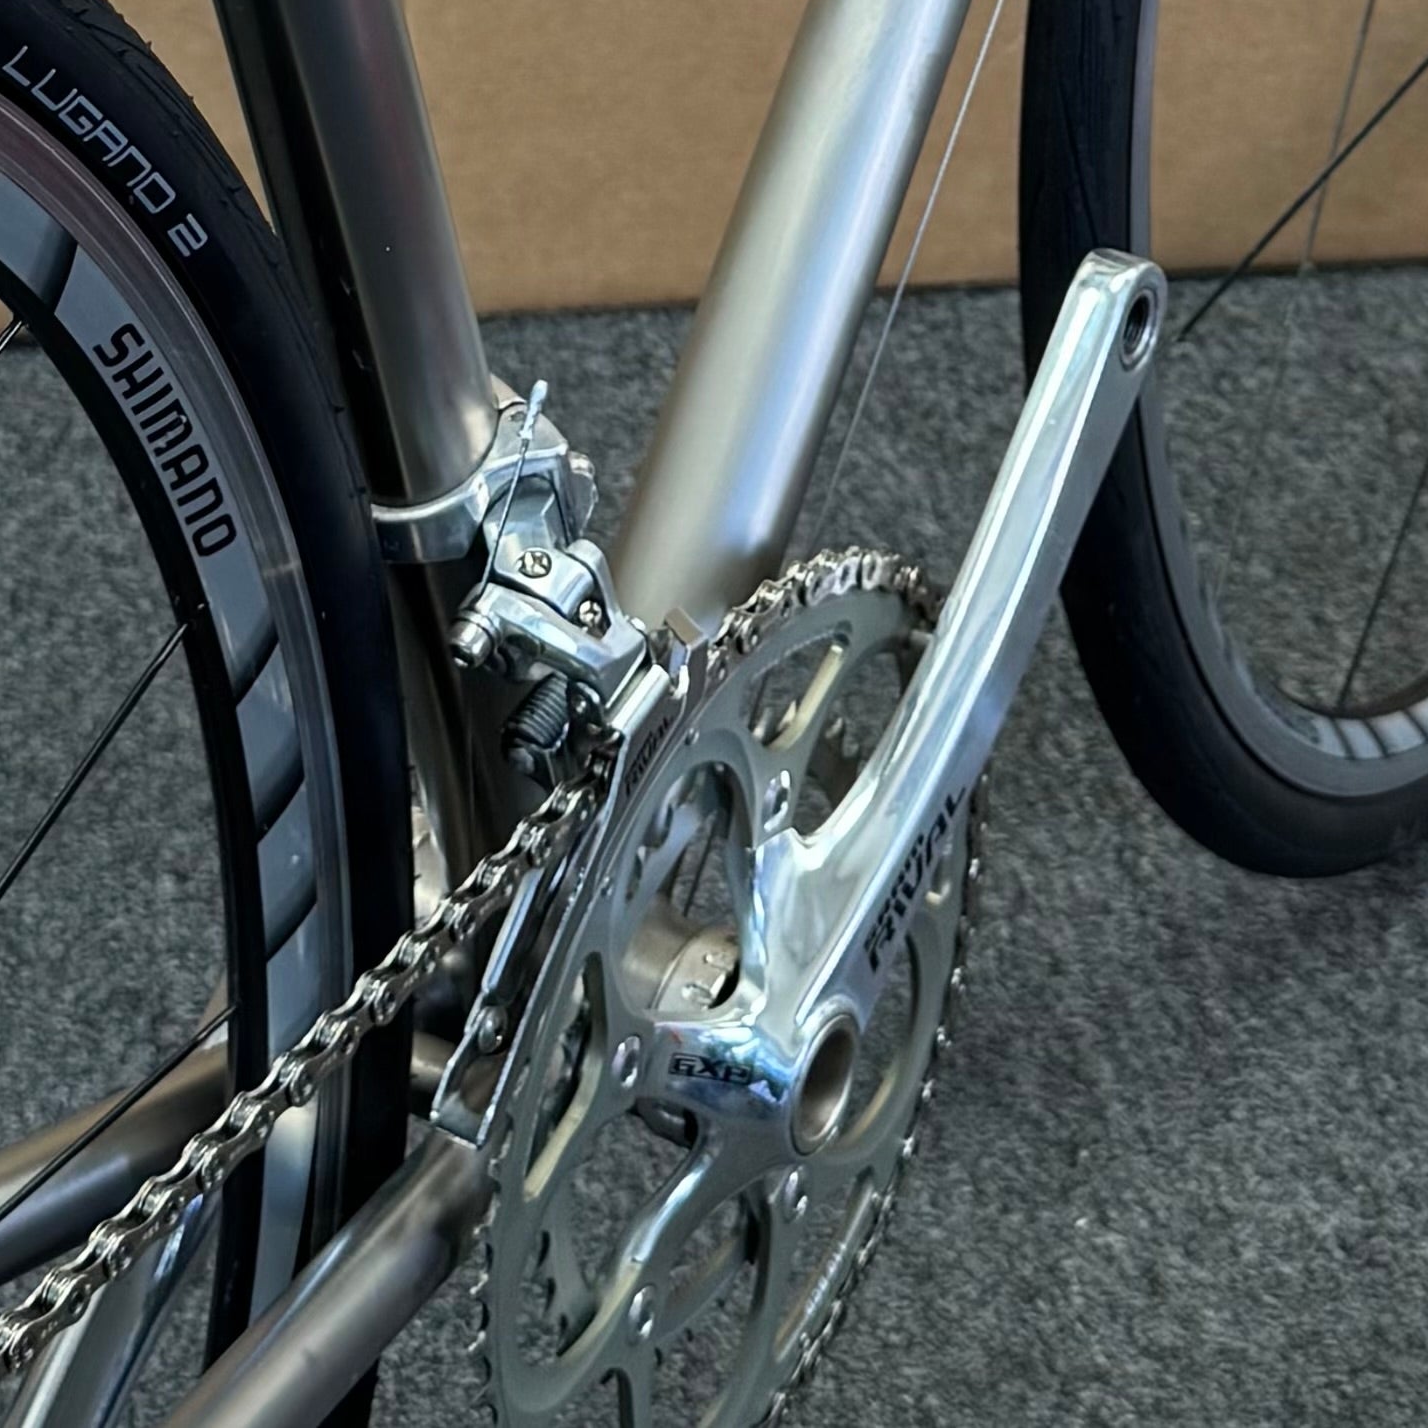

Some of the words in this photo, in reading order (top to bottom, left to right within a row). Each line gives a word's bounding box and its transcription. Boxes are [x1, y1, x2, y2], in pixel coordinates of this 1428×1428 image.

[1, 44, 177, 214] LUGANO
[166, 212, 209, 257] 2
[92, 322, 237, 557] SHIMANO
[868, 786, 967, 973] RIVAL
